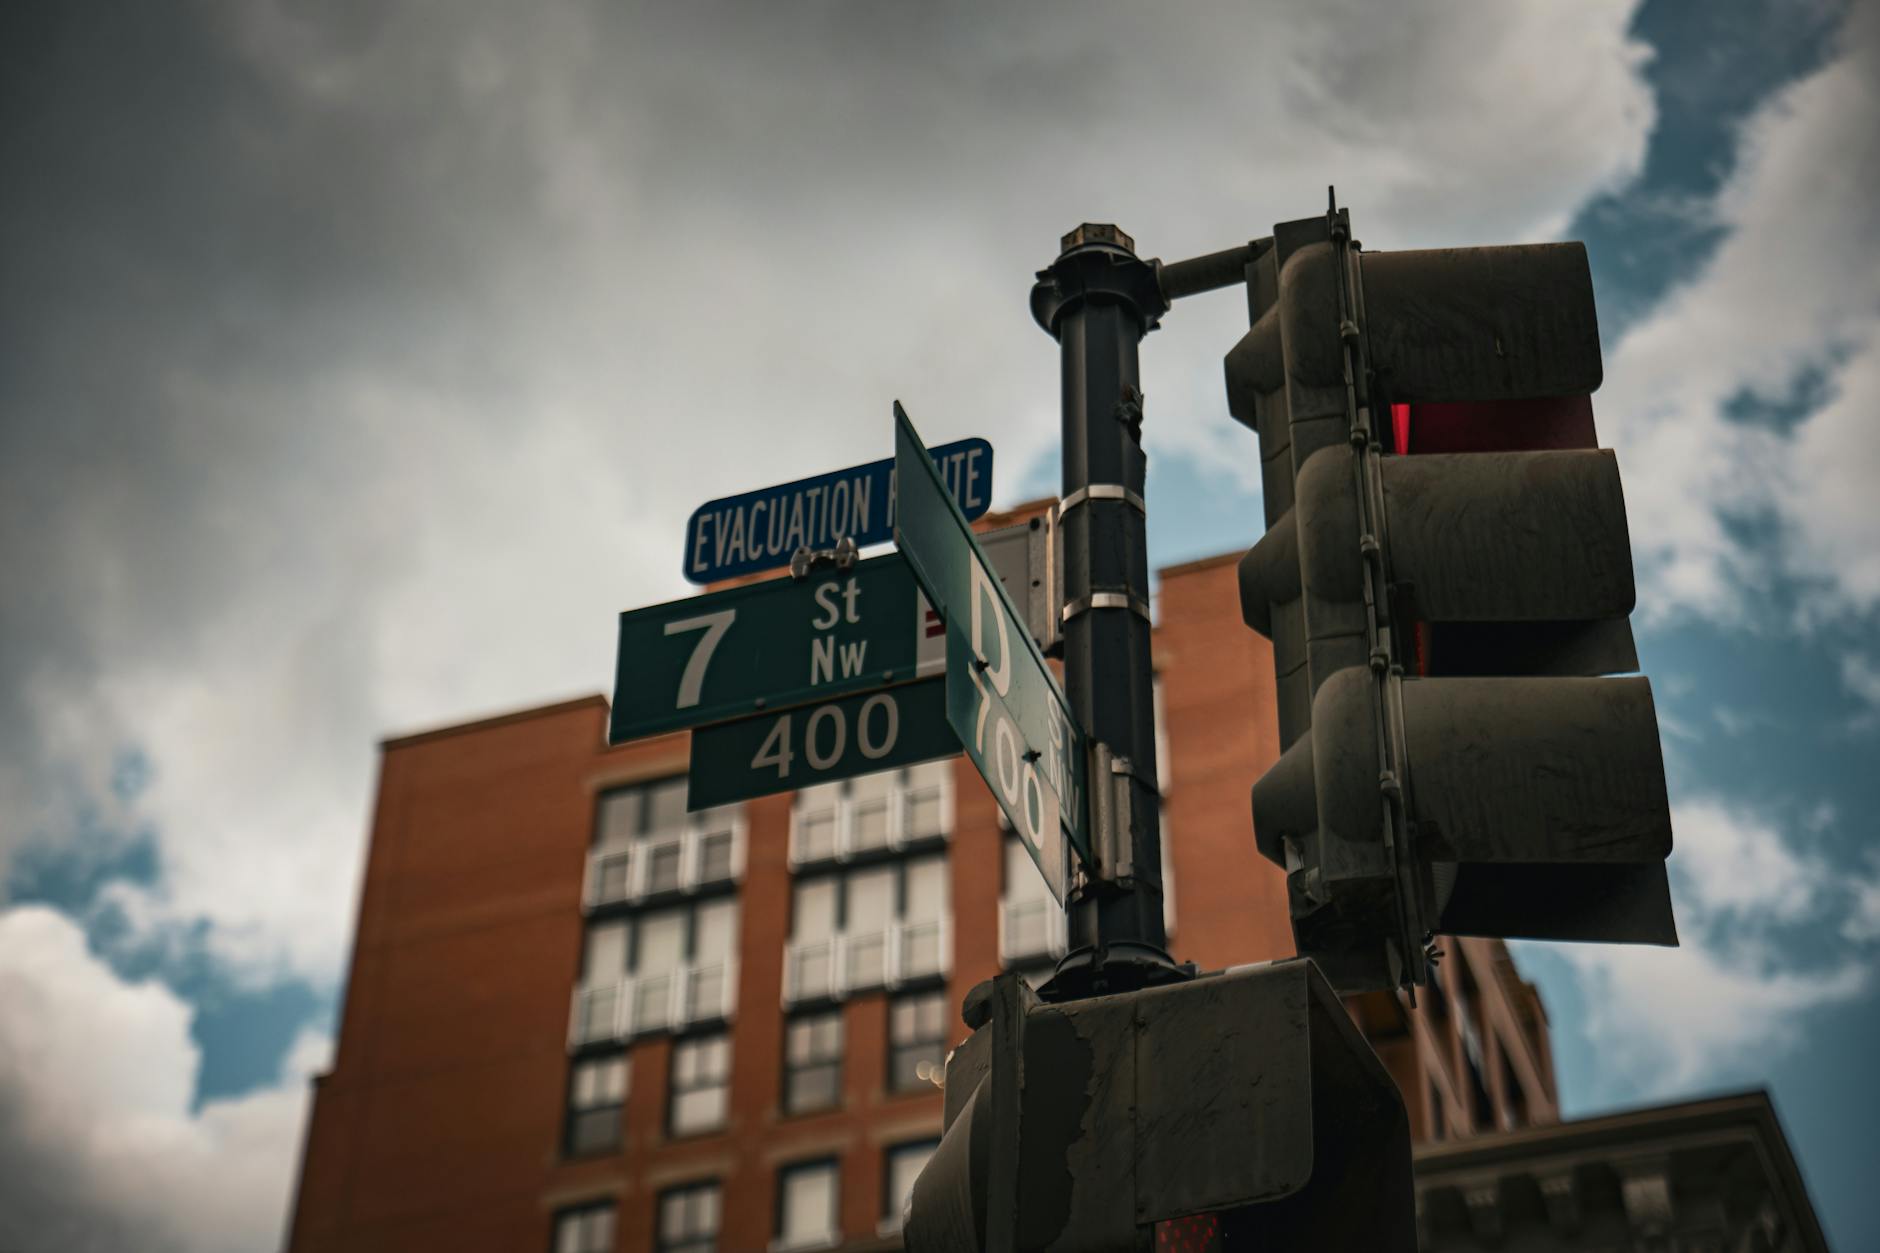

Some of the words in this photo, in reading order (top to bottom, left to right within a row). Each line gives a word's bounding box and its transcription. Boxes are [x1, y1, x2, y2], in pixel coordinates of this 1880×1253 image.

[693, 475, 872, 573] EVACUATION
[886, 447, 983, 528] RTE
[664, 608, 737, 710] 7
[811, 576, 862, 631] St
[969, 550, 1011, 698] D
[751, 693, 900, 779] 400
[968, 660, 1045, 850] 700
